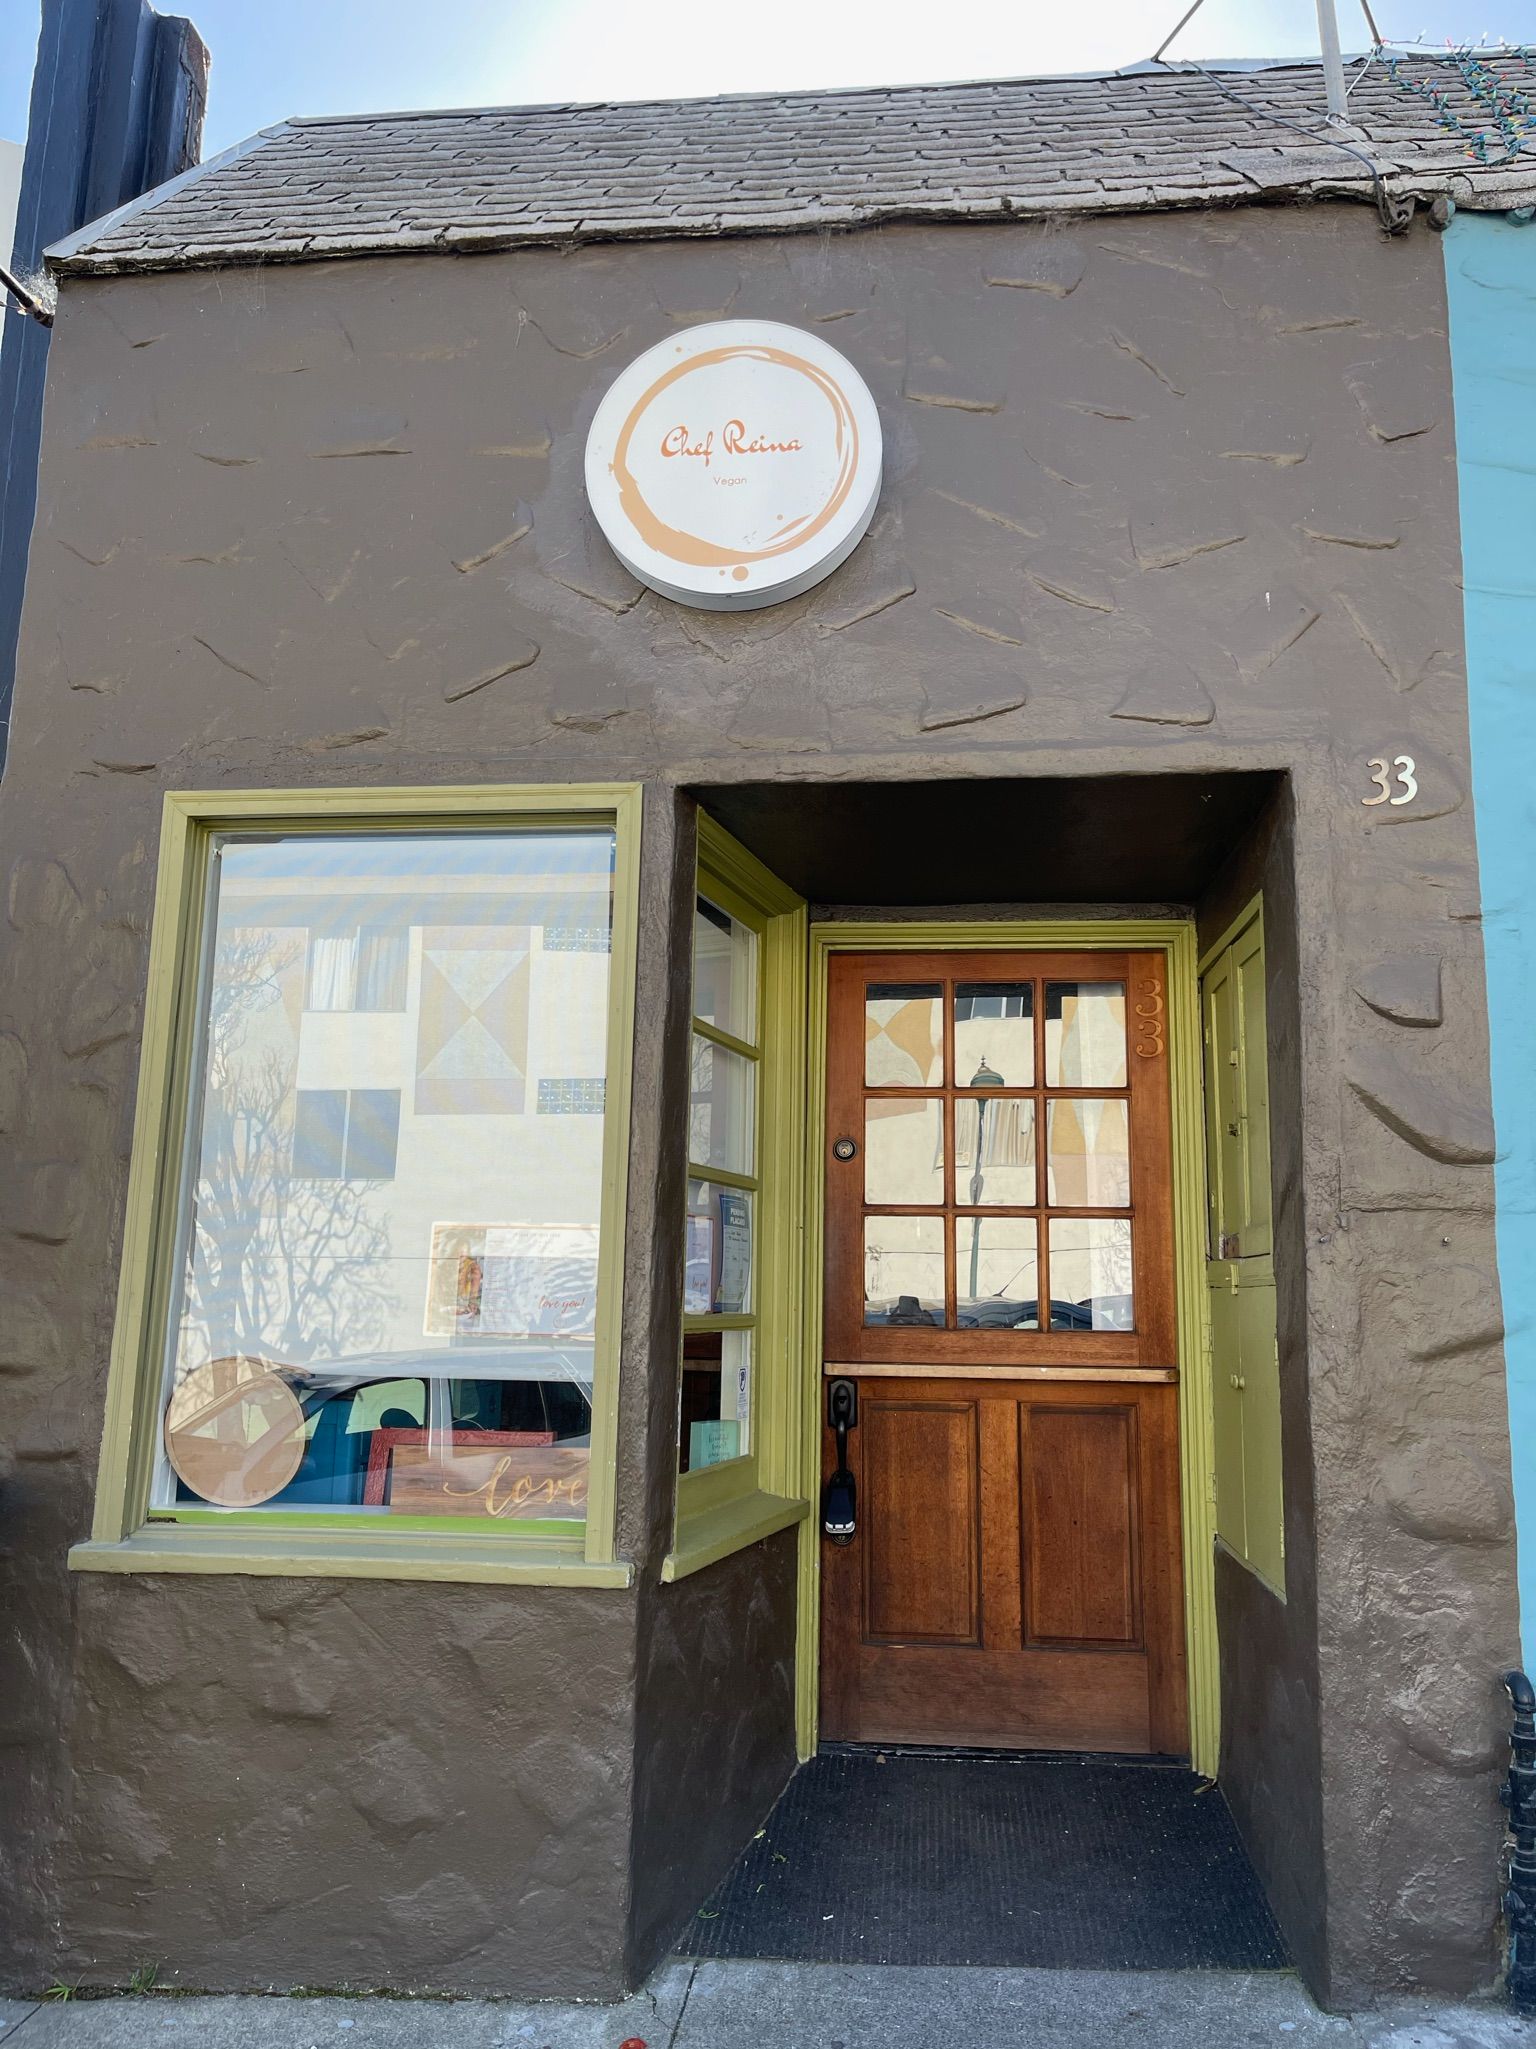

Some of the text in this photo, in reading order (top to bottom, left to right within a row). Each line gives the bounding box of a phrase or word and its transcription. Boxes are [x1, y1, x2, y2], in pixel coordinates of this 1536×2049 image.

[661, 419, 803, 467] Chef Reina
[713, 476, 748, 487] Vegan
[1361, 755, 1418, 806] 33
